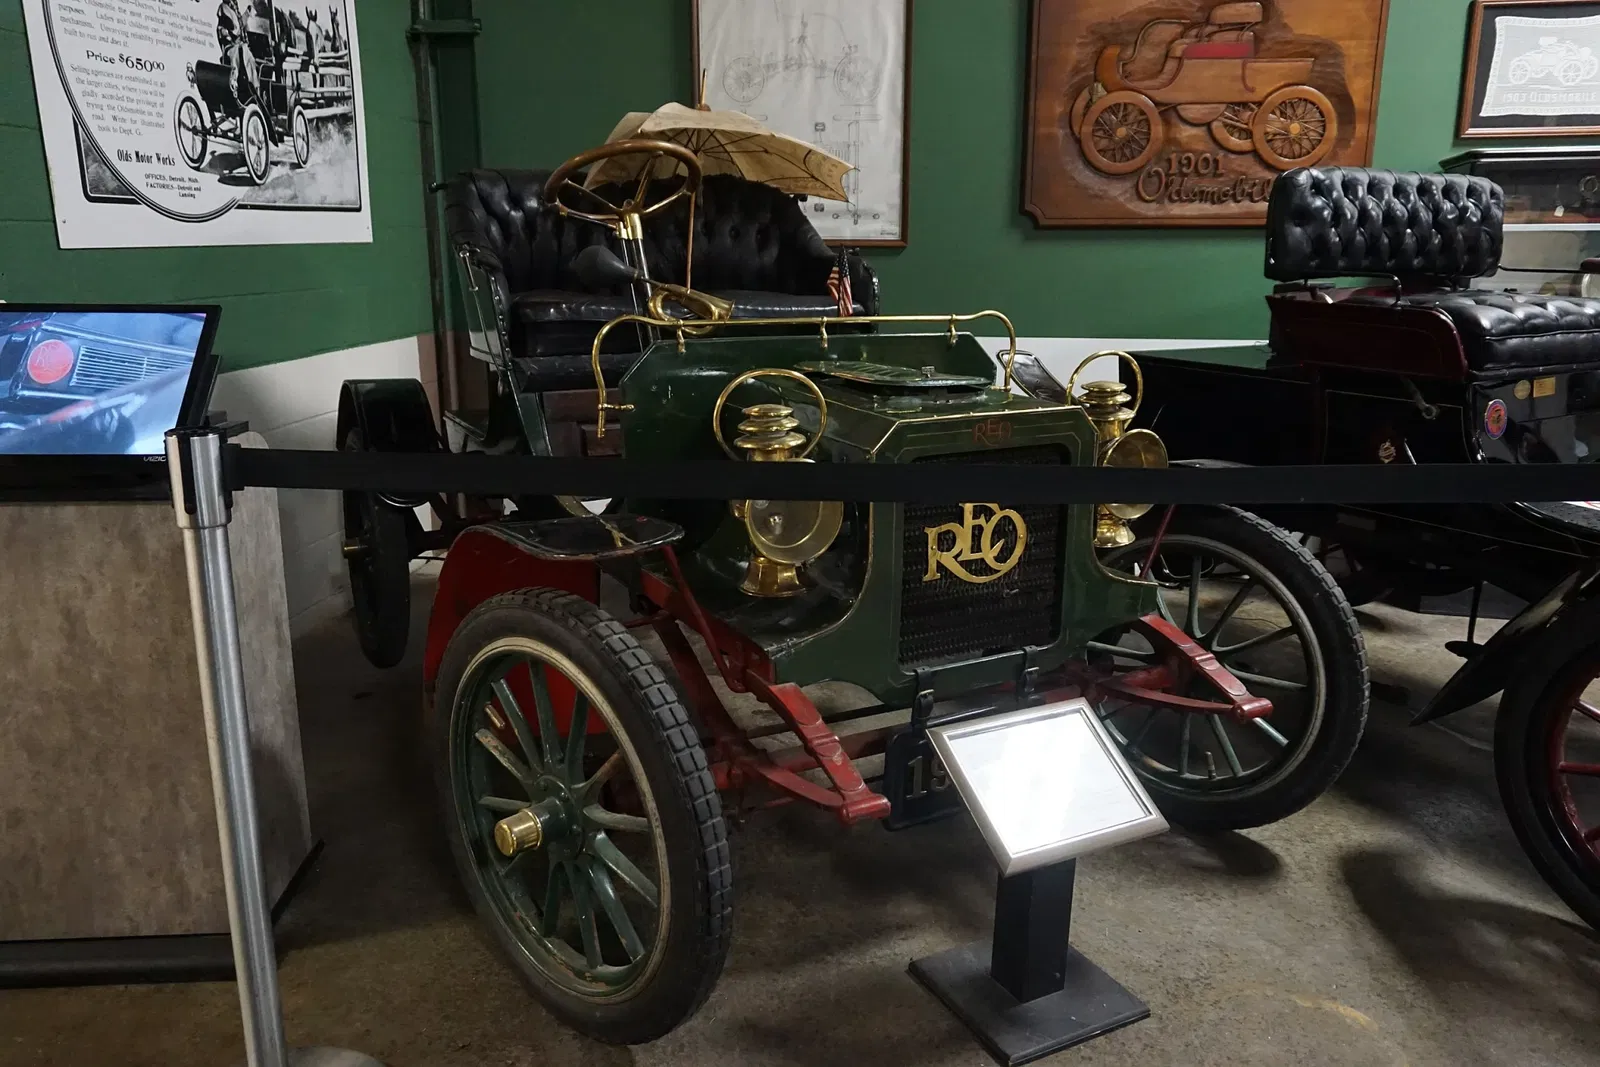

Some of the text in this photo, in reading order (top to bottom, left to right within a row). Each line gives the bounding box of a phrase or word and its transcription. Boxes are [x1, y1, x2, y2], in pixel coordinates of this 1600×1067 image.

[86, 50, 116, 65] Price
[117, 149, 176, 167] Olds Motor Works
[1168, 152, 1225, 176] 1901
[178, 191, 196, 199] Lansing
[1137, 167, 1274, 204] Oldsmobil
[972, 417, 1013, 449] REO
[922, 502, 1028, 583] REO
